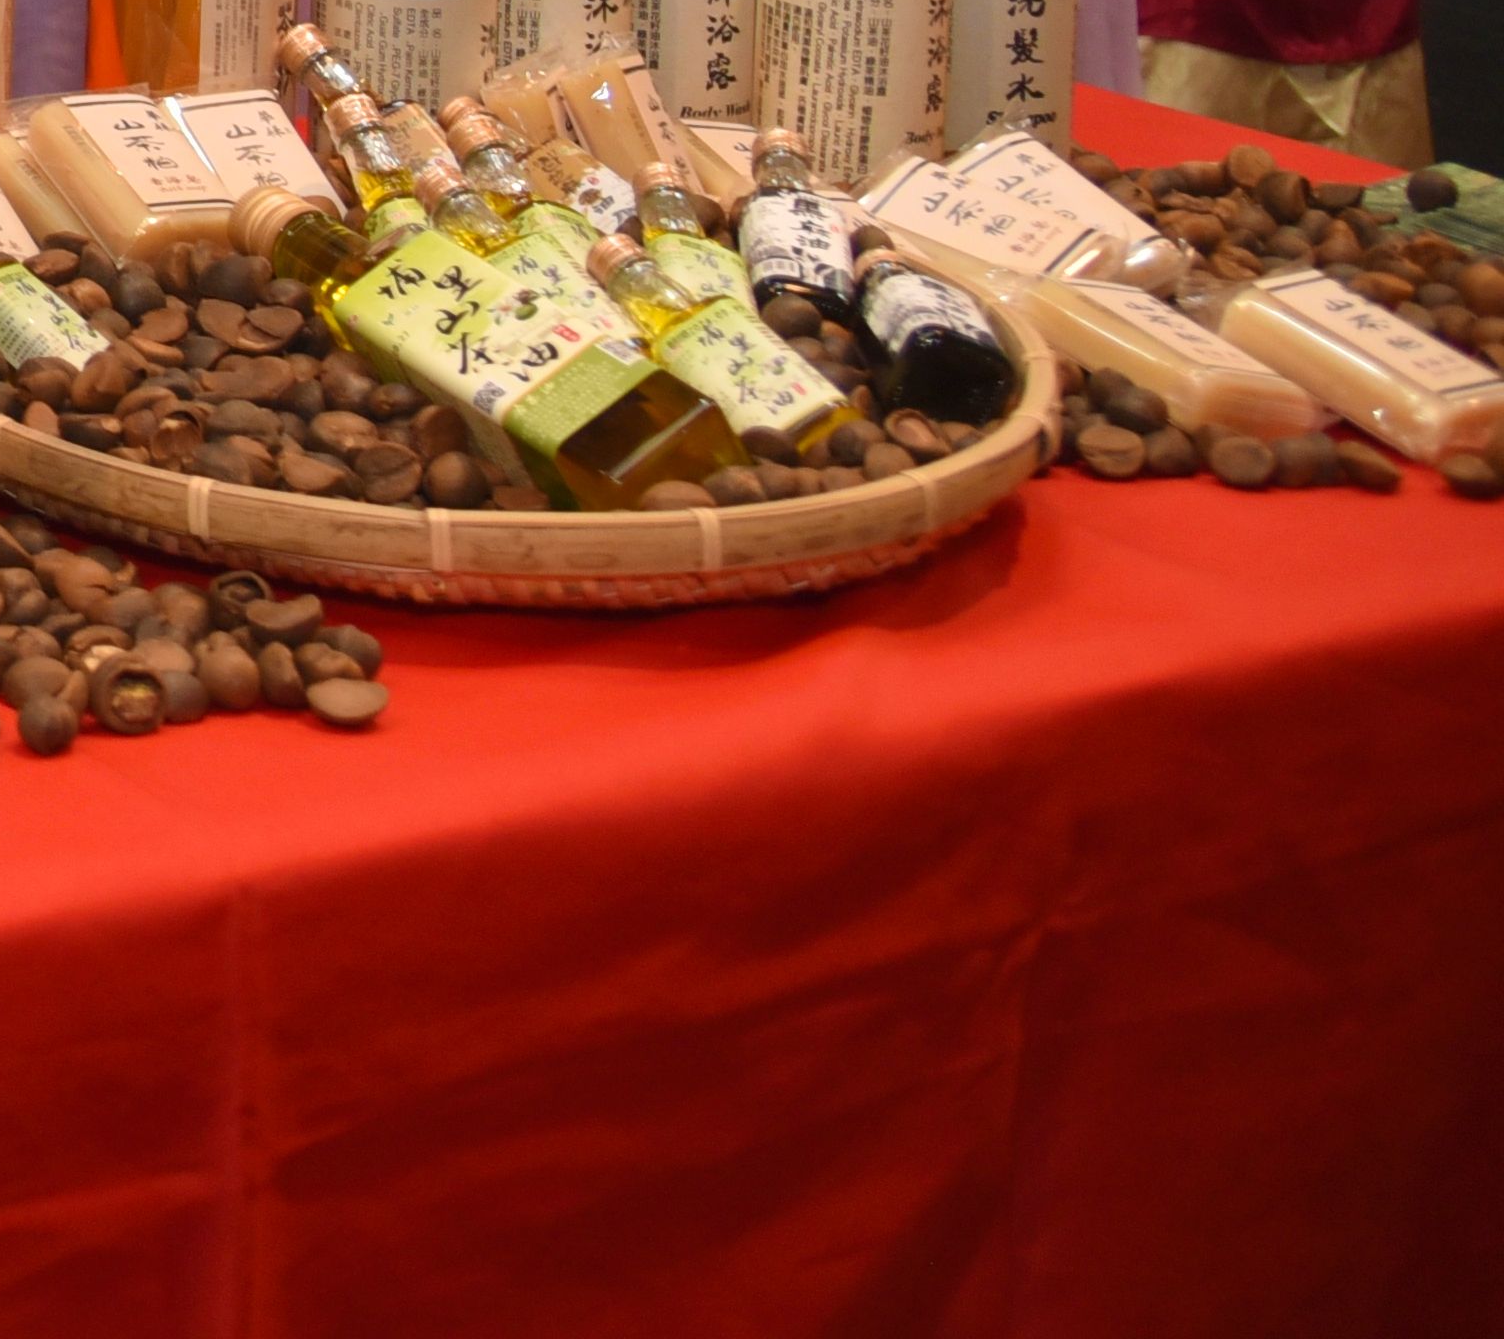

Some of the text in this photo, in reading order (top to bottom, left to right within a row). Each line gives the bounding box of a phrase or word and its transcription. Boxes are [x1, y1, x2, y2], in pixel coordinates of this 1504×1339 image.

[829, 9, 839, 30] Acid
[839, 20, 852, 64] Potassium
[850, 49, 861, 75] EDTA
[824, 73, 834, 93] Acid
[376, 257, 561, 383] 埔里山茶油
